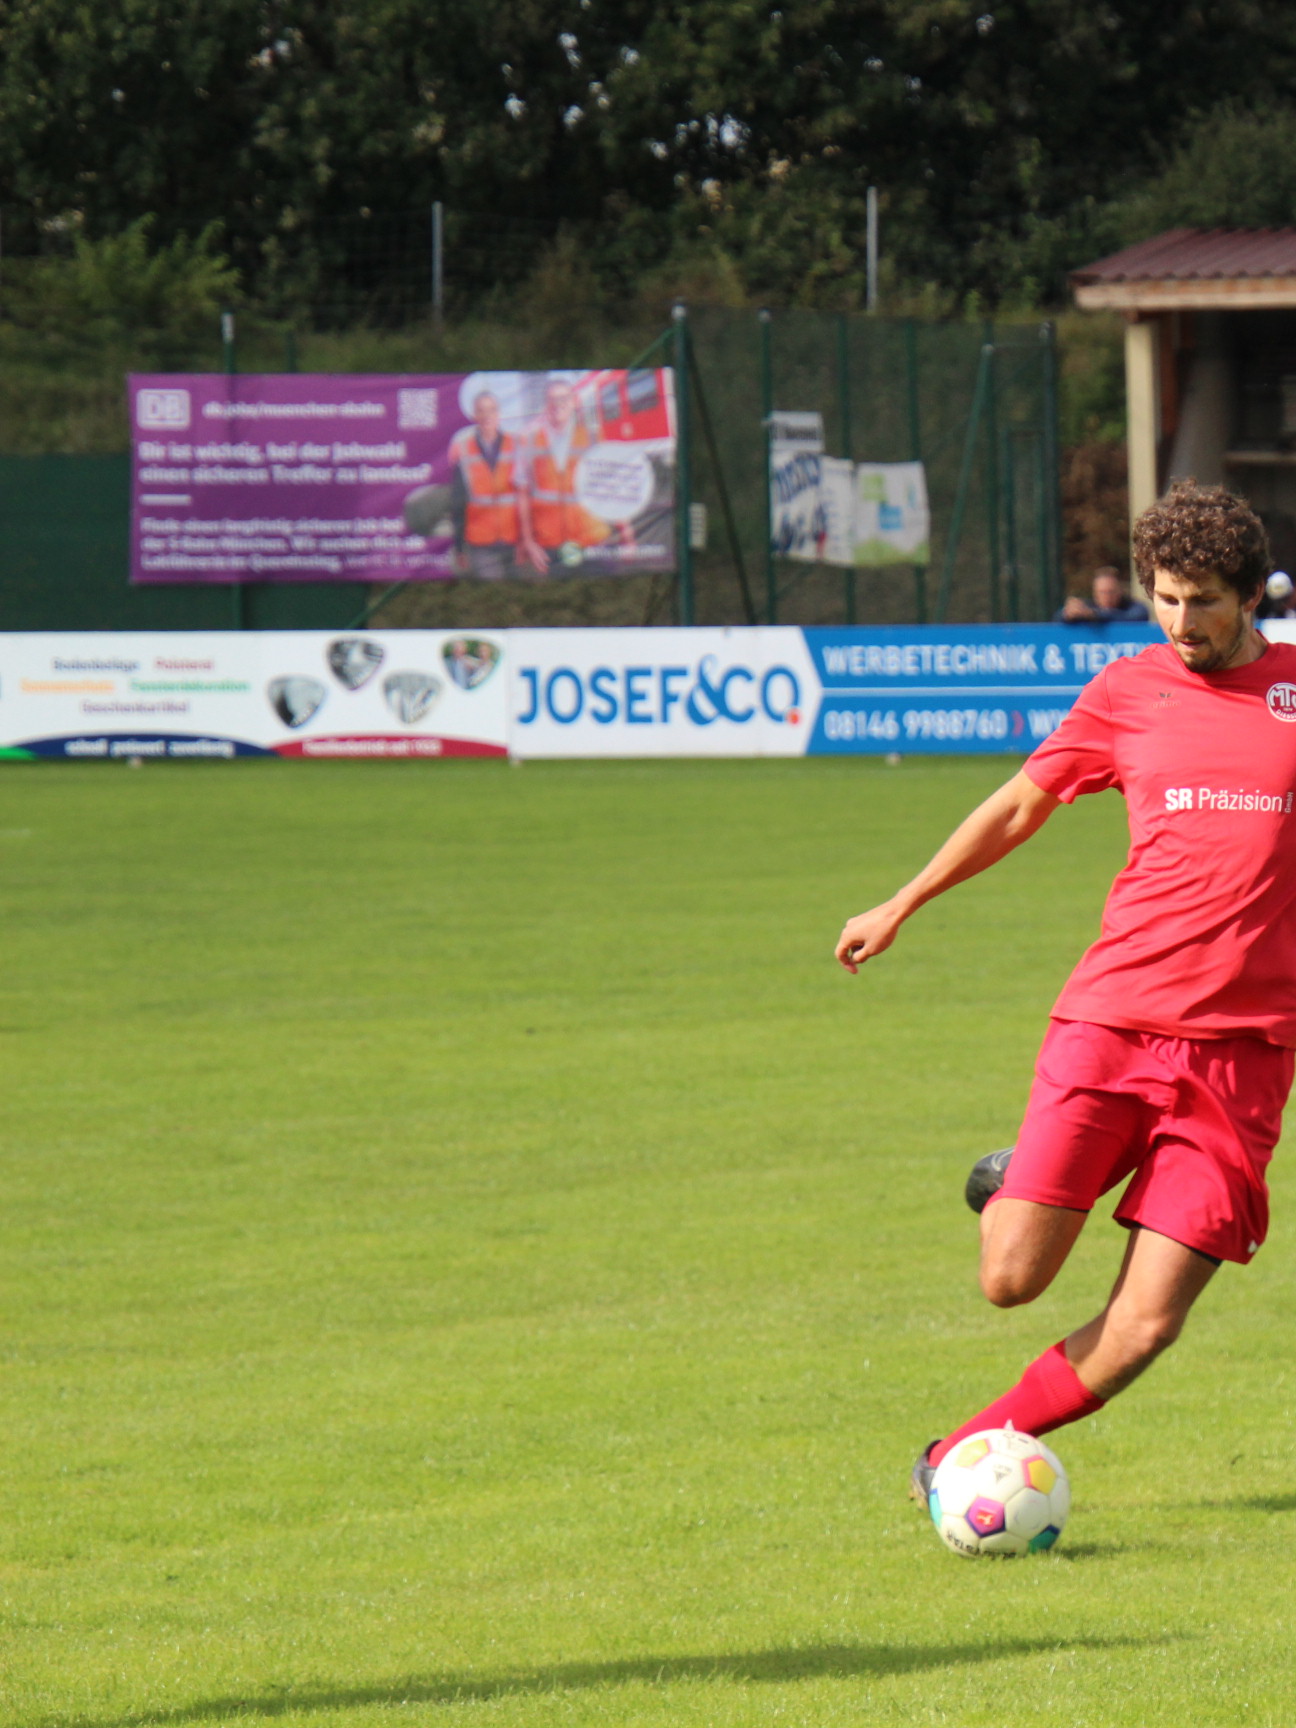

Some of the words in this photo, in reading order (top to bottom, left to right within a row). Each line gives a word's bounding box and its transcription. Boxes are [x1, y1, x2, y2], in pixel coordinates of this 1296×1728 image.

[823, 645, 1037, 675] WERBETECHNIK
[1042, 644, 1065, 673] &
[824, 710, 899, 740] 08146
[1165, 788, 1193, 811] SR
[1198, 788, 1283, 812] Präzision
